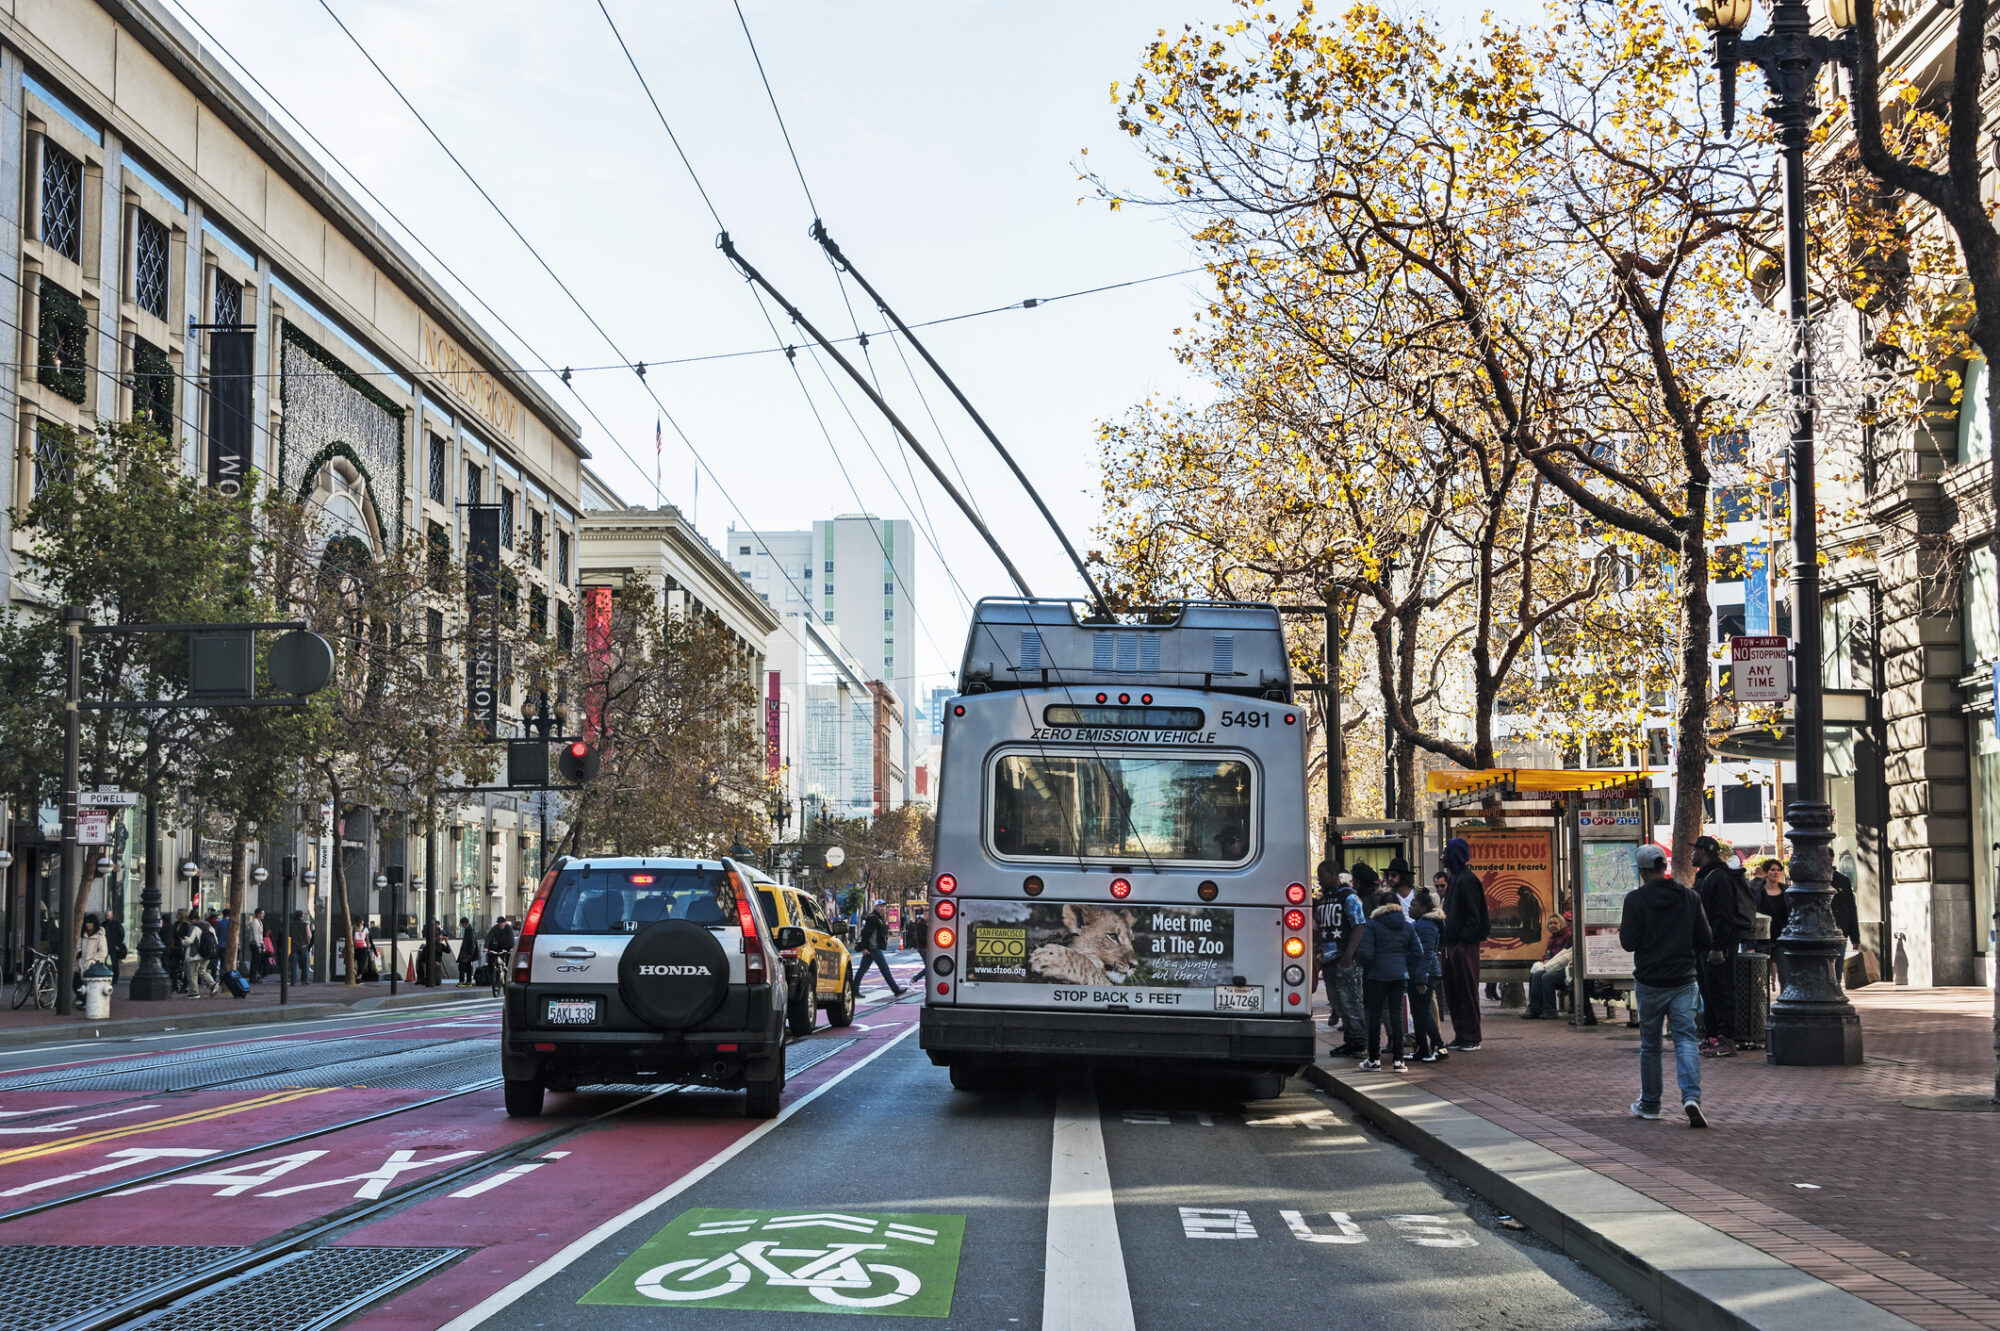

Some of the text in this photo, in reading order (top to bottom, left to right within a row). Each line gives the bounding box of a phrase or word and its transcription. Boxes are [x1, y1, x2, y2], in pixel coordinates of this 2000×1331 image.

[425, 323, 515, 440] NORDSTROM
[1740, 638, 1779, 647] TOW-AWAY
[1733, 647, 1786, 660] NO STOPPING
[1748, 665, 1772, 675] ANY
[1747, 677, 1775, 687] TIME
[1221, 711, 1270, 728] 5491
[1030, 728, 1216, 744] ZERO EMISSION VEHICLE
[90, 794, 126, 803] POWELL
[1540, 790, 1564, 800] RAPID
[1600, 789, 1625, 799] RAPID
[1517, 863, 1547, 871] Secrets
[1152, 914, 1212, 932] Meet me
[980, 929, 1024, 938] SAN FRANCISCO
[977, 940, 1024, 956] ZOO
[1151, 936, 1224, 954] at The Zoo
[639, 965, 712, 976] HONDA
[974, 965, 1027, 977] www.sfzoo.org
[1152, 970, 1208, 981] out there!
[1053, 990, 1182, 1005] STOP BACK 5 FEET
[550, 1007, 594, 1020] 5AKL338
[1178, 1206, 1481, 1248] BUS
